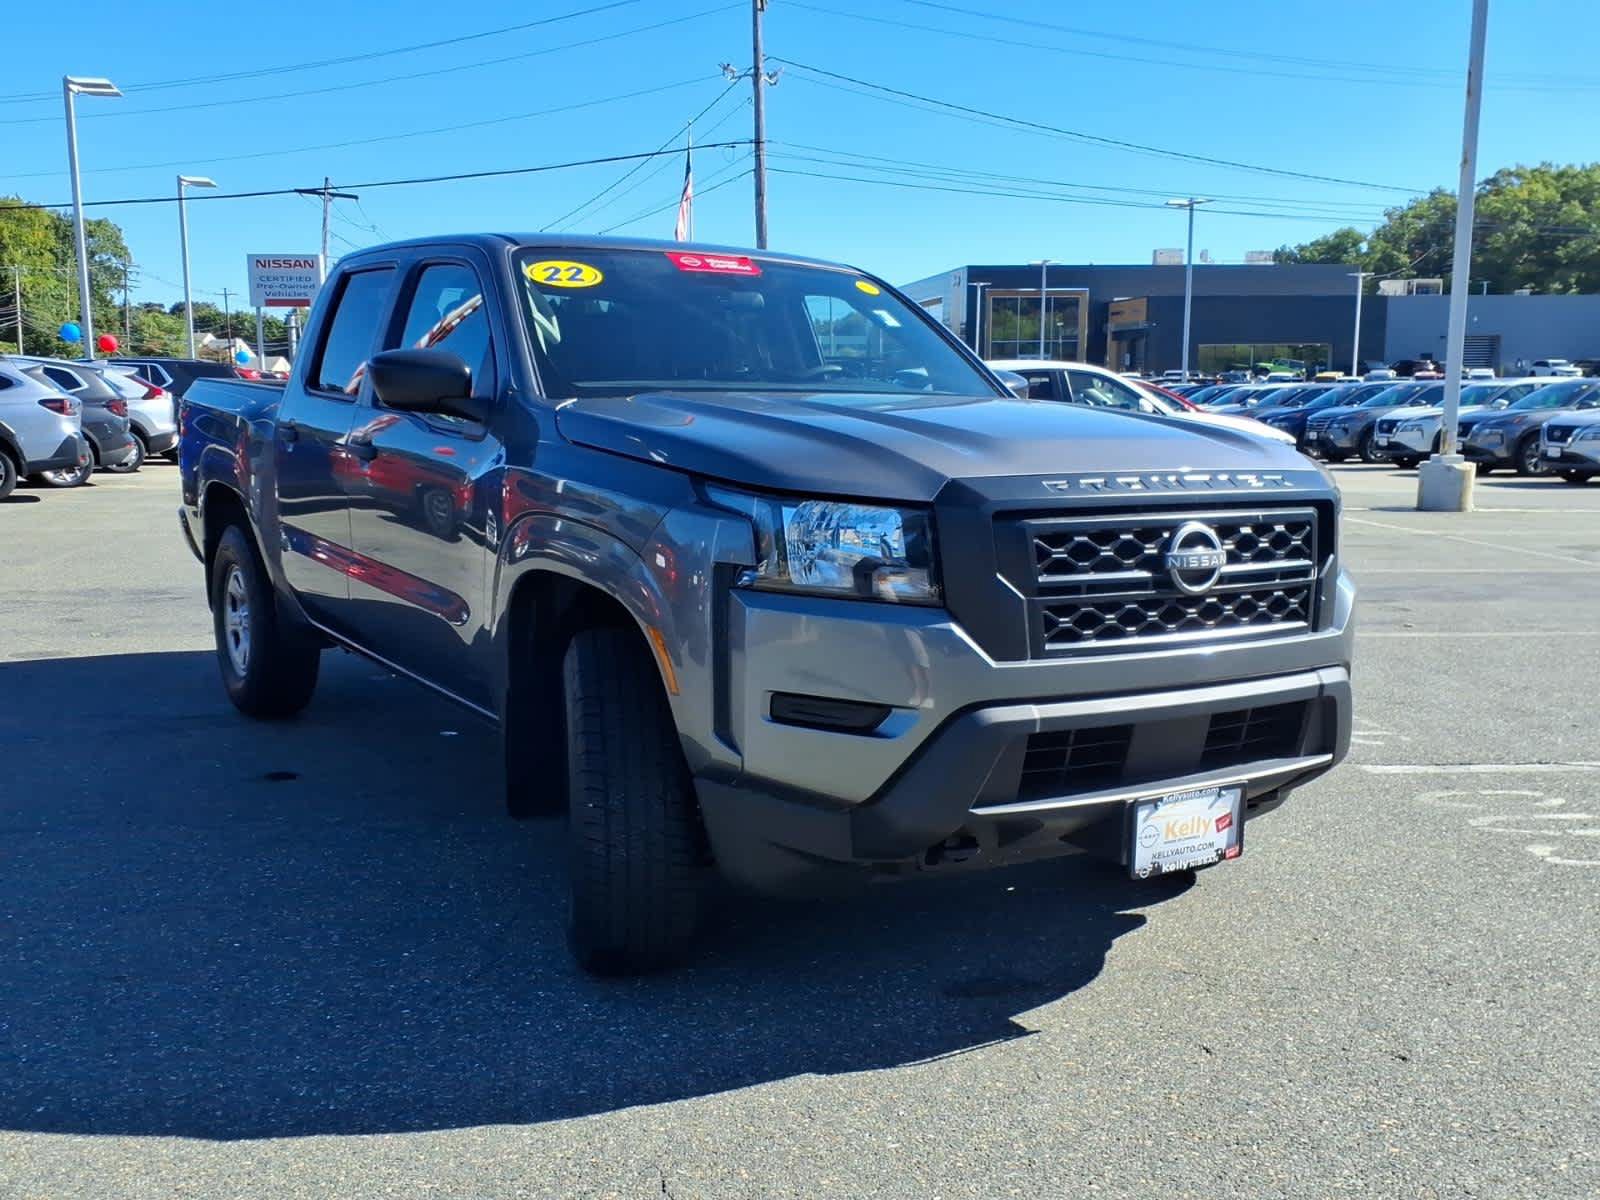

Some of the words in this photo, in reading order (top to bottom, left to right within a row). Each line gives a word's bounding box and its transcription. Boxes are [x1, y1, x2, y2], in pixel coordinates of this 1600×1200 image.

[256, 259, 314, 268] NISSAN
[542, 265, 585, 282] 22
[1167, 551, 1227, 568] NISSAN
[1164, 815, 1212, 840] Kelly
[1151, 842, 1215, 860] KELLYAUTO.COM
[1161, 860, 1190, 873] Kelly
